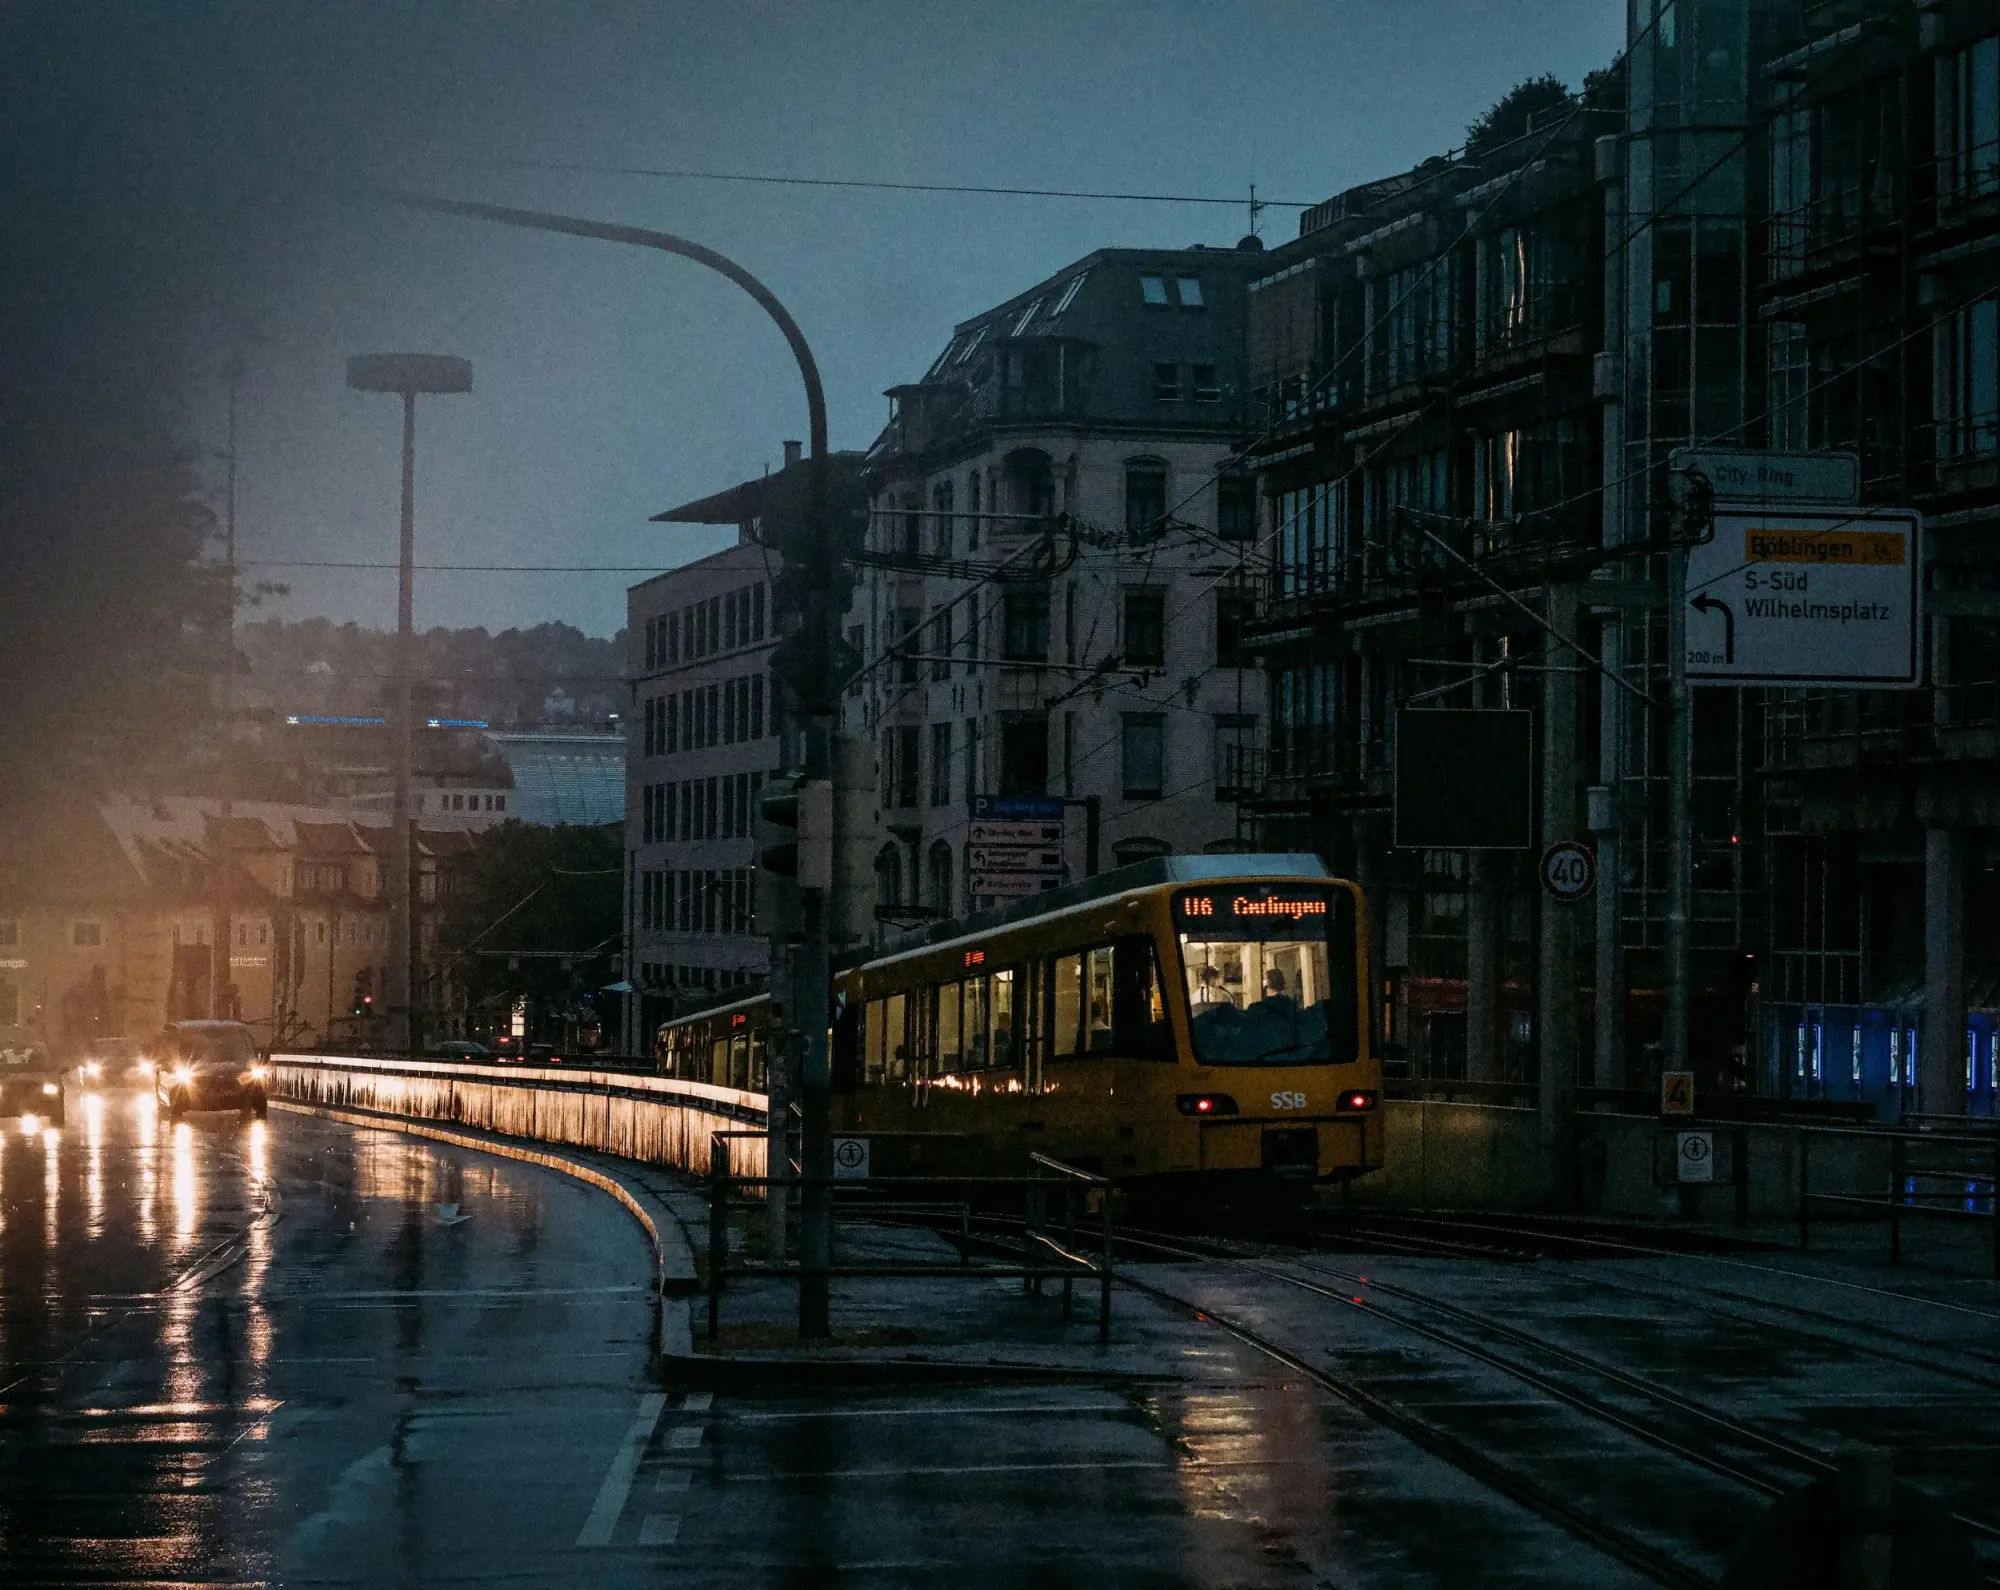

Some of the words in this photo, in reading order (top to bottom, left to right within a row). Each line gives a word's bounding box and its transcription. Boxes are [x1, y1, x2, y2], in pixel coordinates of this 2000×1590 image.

[1715, 465, 1794, 486] City-Ring
[1751, 535, 1853, 561] Böblingen
[1745, 571, 1808, 591] S-Süd
[1745, 598, 1890, 624] Wilhelmsplatz
[1687, 651, 1710, 664] 200
[1712, 655, 1724, 664] m
[975, 798, 988, 815] P
[1553, 858, 1585, 884] 40
[1232, 895, 1328, 921] Gerlingen
[1270, 1091, 1307, 1110] SSB
[1668, 1079, 1686, 1107] 4
